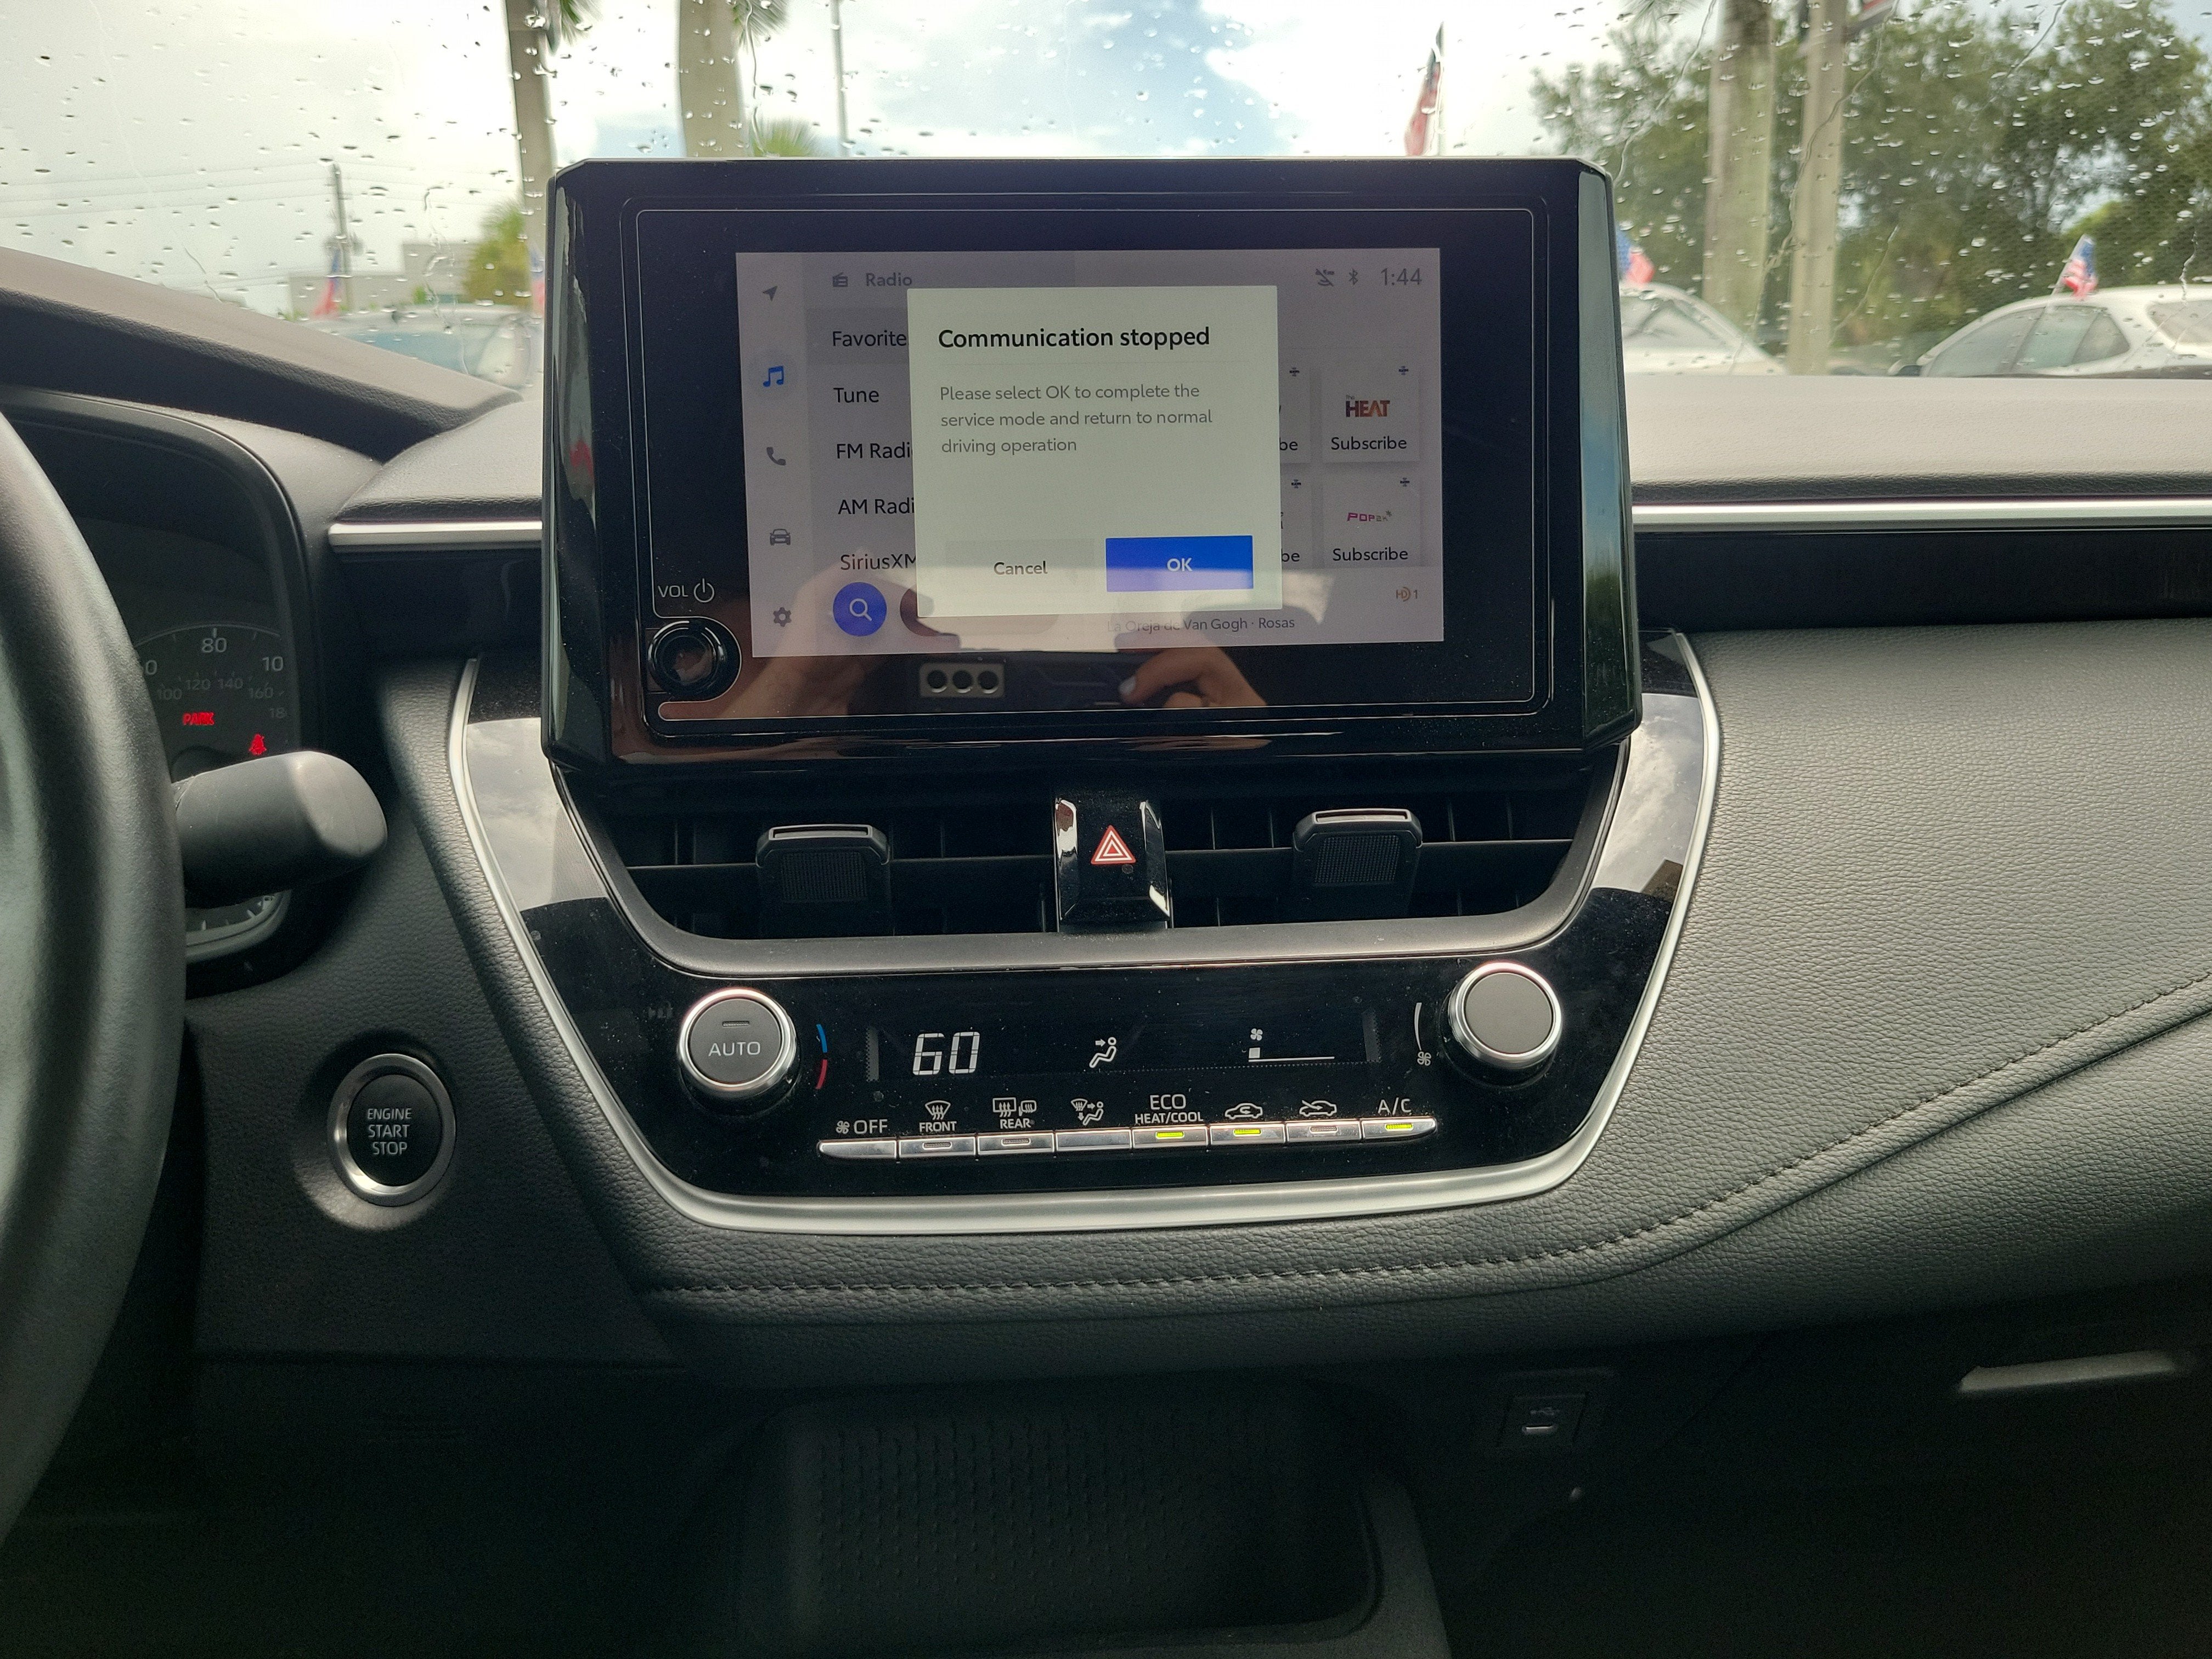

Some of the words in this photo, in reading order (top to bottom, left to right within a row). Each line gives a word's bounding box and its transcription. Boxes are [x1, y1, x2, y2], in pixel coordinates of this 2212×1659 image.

[866, 273, 912, 286] Radio
[1381, 268, 1423, 286] 1:44
[832, 330, 907, 347] Favorite
[939, 328, 1113, 348] Communication
[1120, 326, 1209, 350] stopped
[833, 387, 879, 403] Tune
[940, 386, 991, 400] Please
[995, 385, 1042, 400] select
[1046, 385, 1070, 399] OK
[1074, 386, 1091, 399] to
[1095, 384, 1170, 402] complete
[1174, 383, 1200, 397] the
[1345, 400, 1390, 417] HEAT
[941, 413, 995, 427] service
[1000, 411, 1045, 426] mode
[1049, 410, 1079, 425] and
[1084, 412, 1131, 425] return
[1136, 411, 1153, 424] to
[1156, 409, 1212, 424] normal
[837, 443, 863, 459] FM
[870, 442, 912, 459] Radi
[941, 438, 996, 456] driving
[1001, 437, 1077, 455] operation
[1331, 436, 1407, 450] Subscribe
[838, 499, 868, 515] AM
[1333, 546, 1408, 561] Subscribe
[840, 554, 916, 570] SiriusXM
[994, 561, 1048, 575] Cancel
[1167, 558, 1192, 572] OK
[658, 585, 689, 598] VOL
[1183, 619, 1207, 630] Van
[1210, 617, 1248, 633] Gogh
[1259, 617, 1295, 629] Rosas
[201, 637, 227, 653] 80
[708, 1041, 761, 1056] AUTO
[912, 1031, 980, 1075] 60
[1149, 1094, 1187, 1110] ECO
[1378, 1097, 1412, 1115] A/C
[367, 1108, 412, 1120] ENGINE
[1135, 1110, 1204, 1125] HEAT/COOL
[368, 1124, 410, 1138] START
[854, 1119, 888, 1135] OFF
[919, 1121, 957, 1132] FRONT
[1000, 1118, 1031, 1129] REAR
[372, 1141, 408, 1155] STOP
